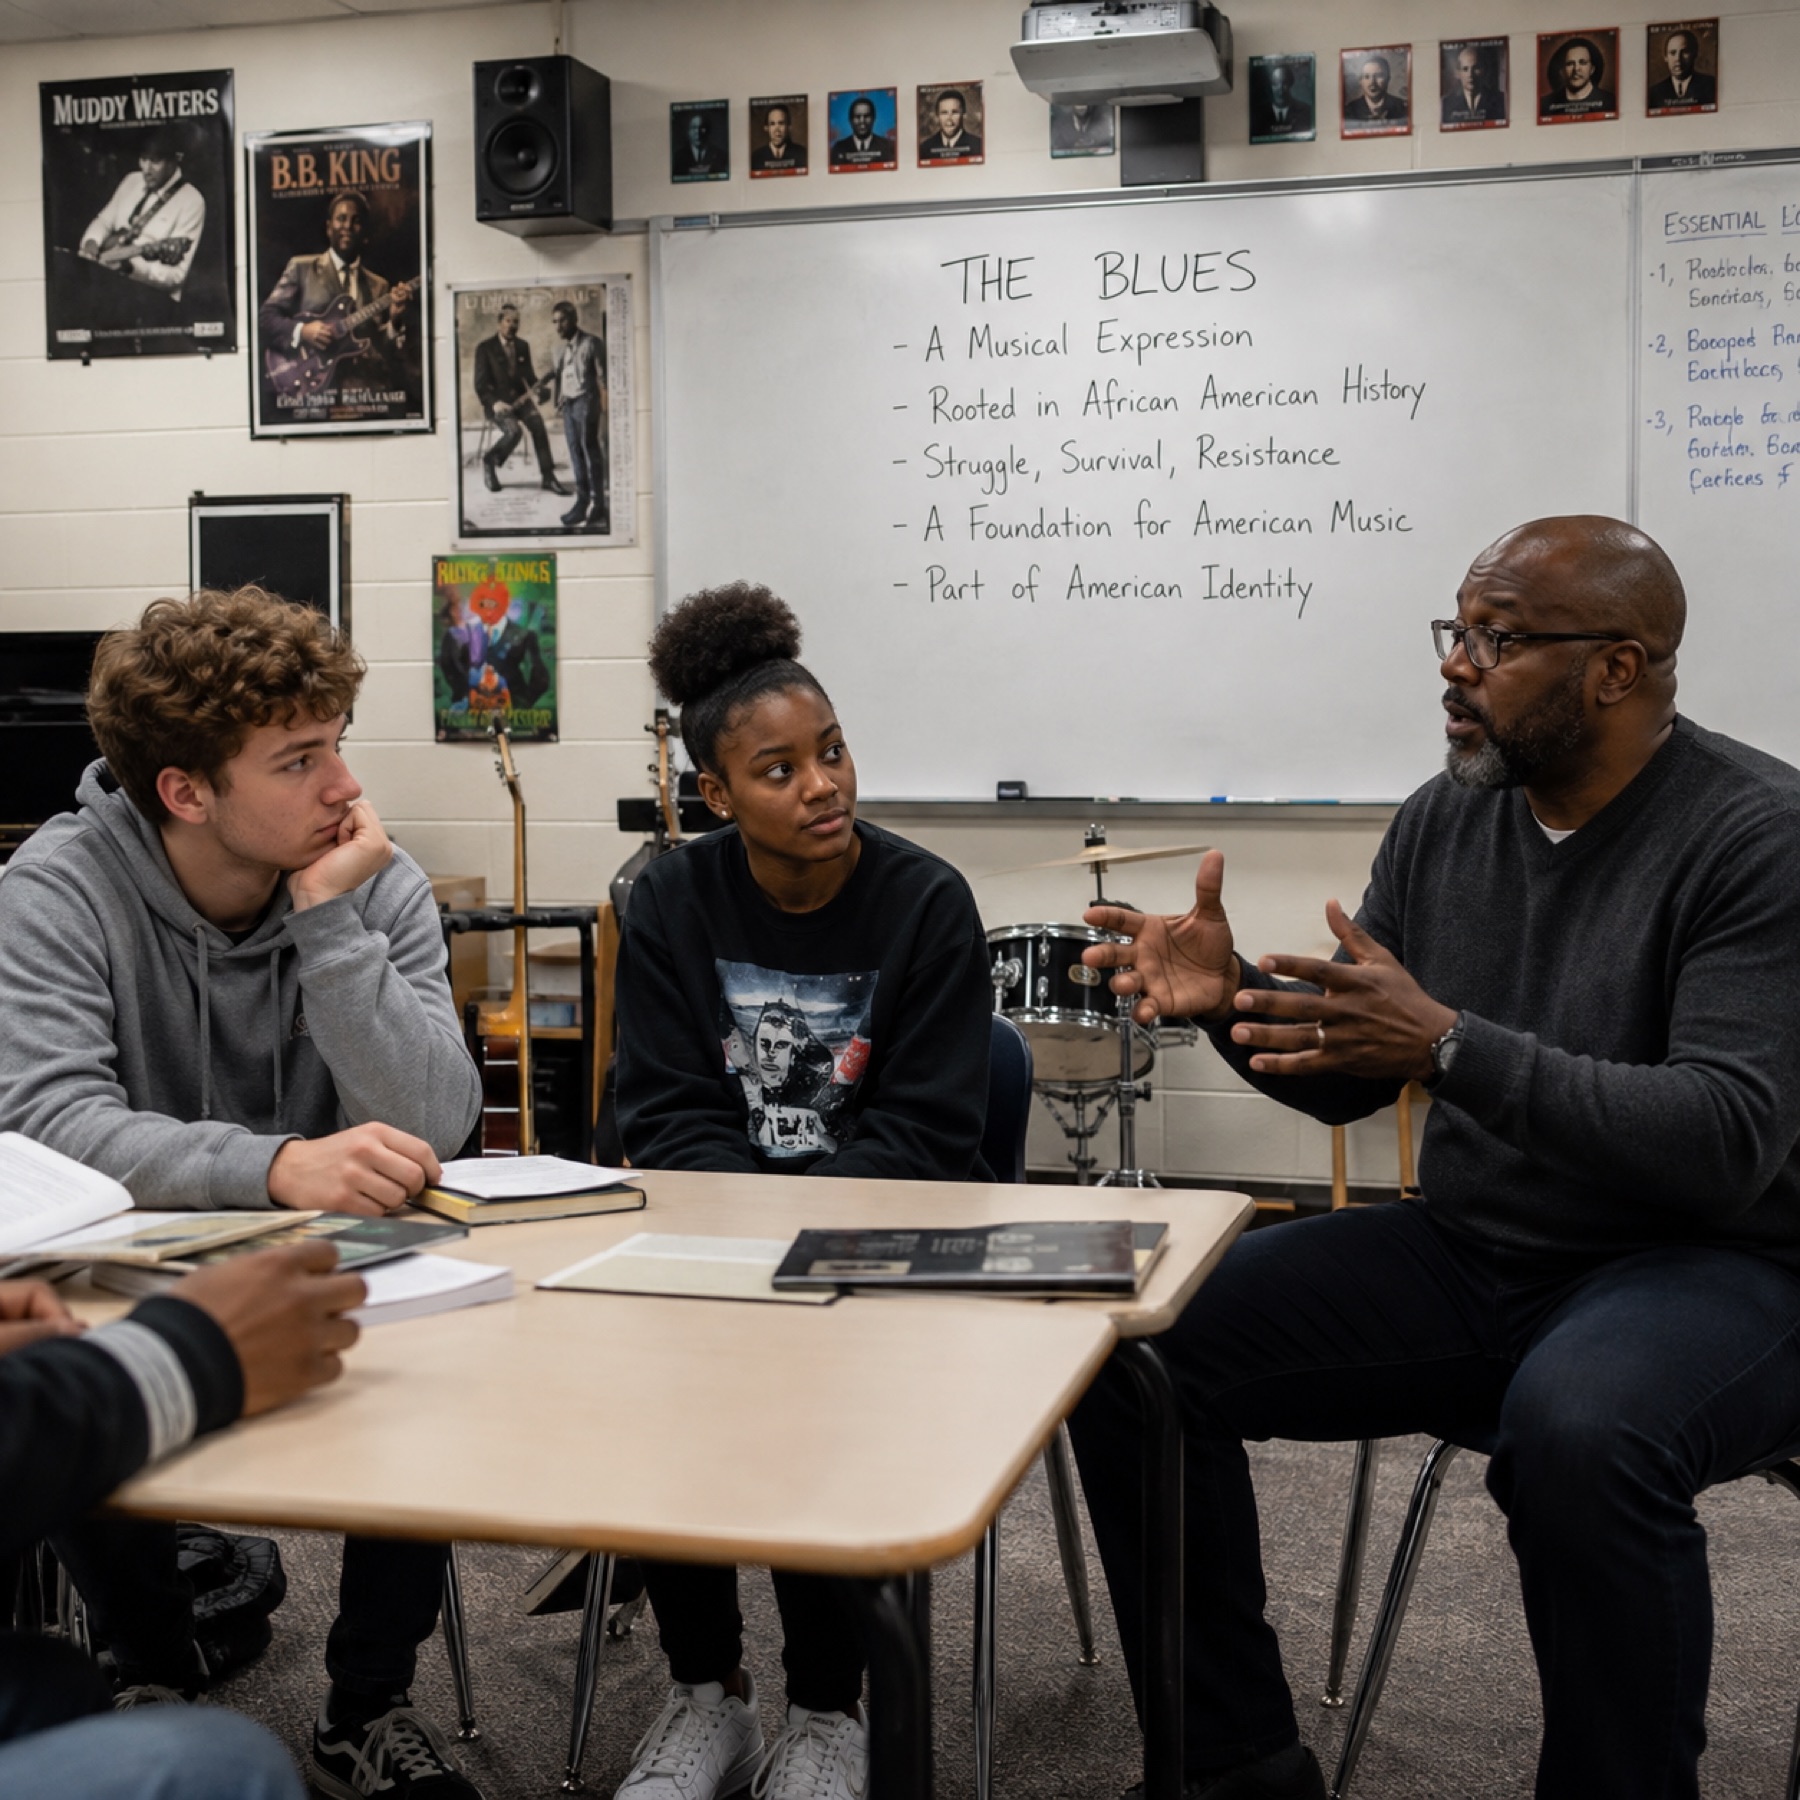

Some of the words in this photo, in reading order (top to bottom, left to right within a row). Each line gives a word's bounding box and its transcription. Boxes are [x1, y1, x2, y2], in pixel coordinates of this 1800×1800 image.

[53, 94, 128, 126] MUDDY
[131, 88, 219, 121] WATERS
[271, 152, 323, 190] B.B.
[329, 148, 401, 186] KING
[1664, 210, 1767, 236] ESSENTIAL
[940, 254, 1035, 304] THE
[1094, 250, 1256, 300] BLUES
[926, 325, 945, 363] A
[969, 322, 1068, 360] Musical
[1097, 319, 1253, 367] Expression
[929, 386, 1017, 424] Rooted
[1037, 391, 1060, 417] in
[1083, 378, 1179, 420] African
[1200, 374, 1319, 411] American
[1343, 364, 1427, 420] History
[924, 443, 1041, 495] Struggle,
[1061, 439, 1175, 480] Survival,
[1197, 434, 1341, 470] Resistance
[924, 505, 944, 542] A
[969, 503, 1112, 541] Foundation
[1133, 498, 1172, 539] for
[1193, 499, 1313, 537] American
[1331, 499, 1414, 534] Music
[926, 565, 986, 603] Part
[1012, 564, 1041, 603] of
[1066, 562, 1183, 601] American
[1201, 564, 1313, 619] Identity
